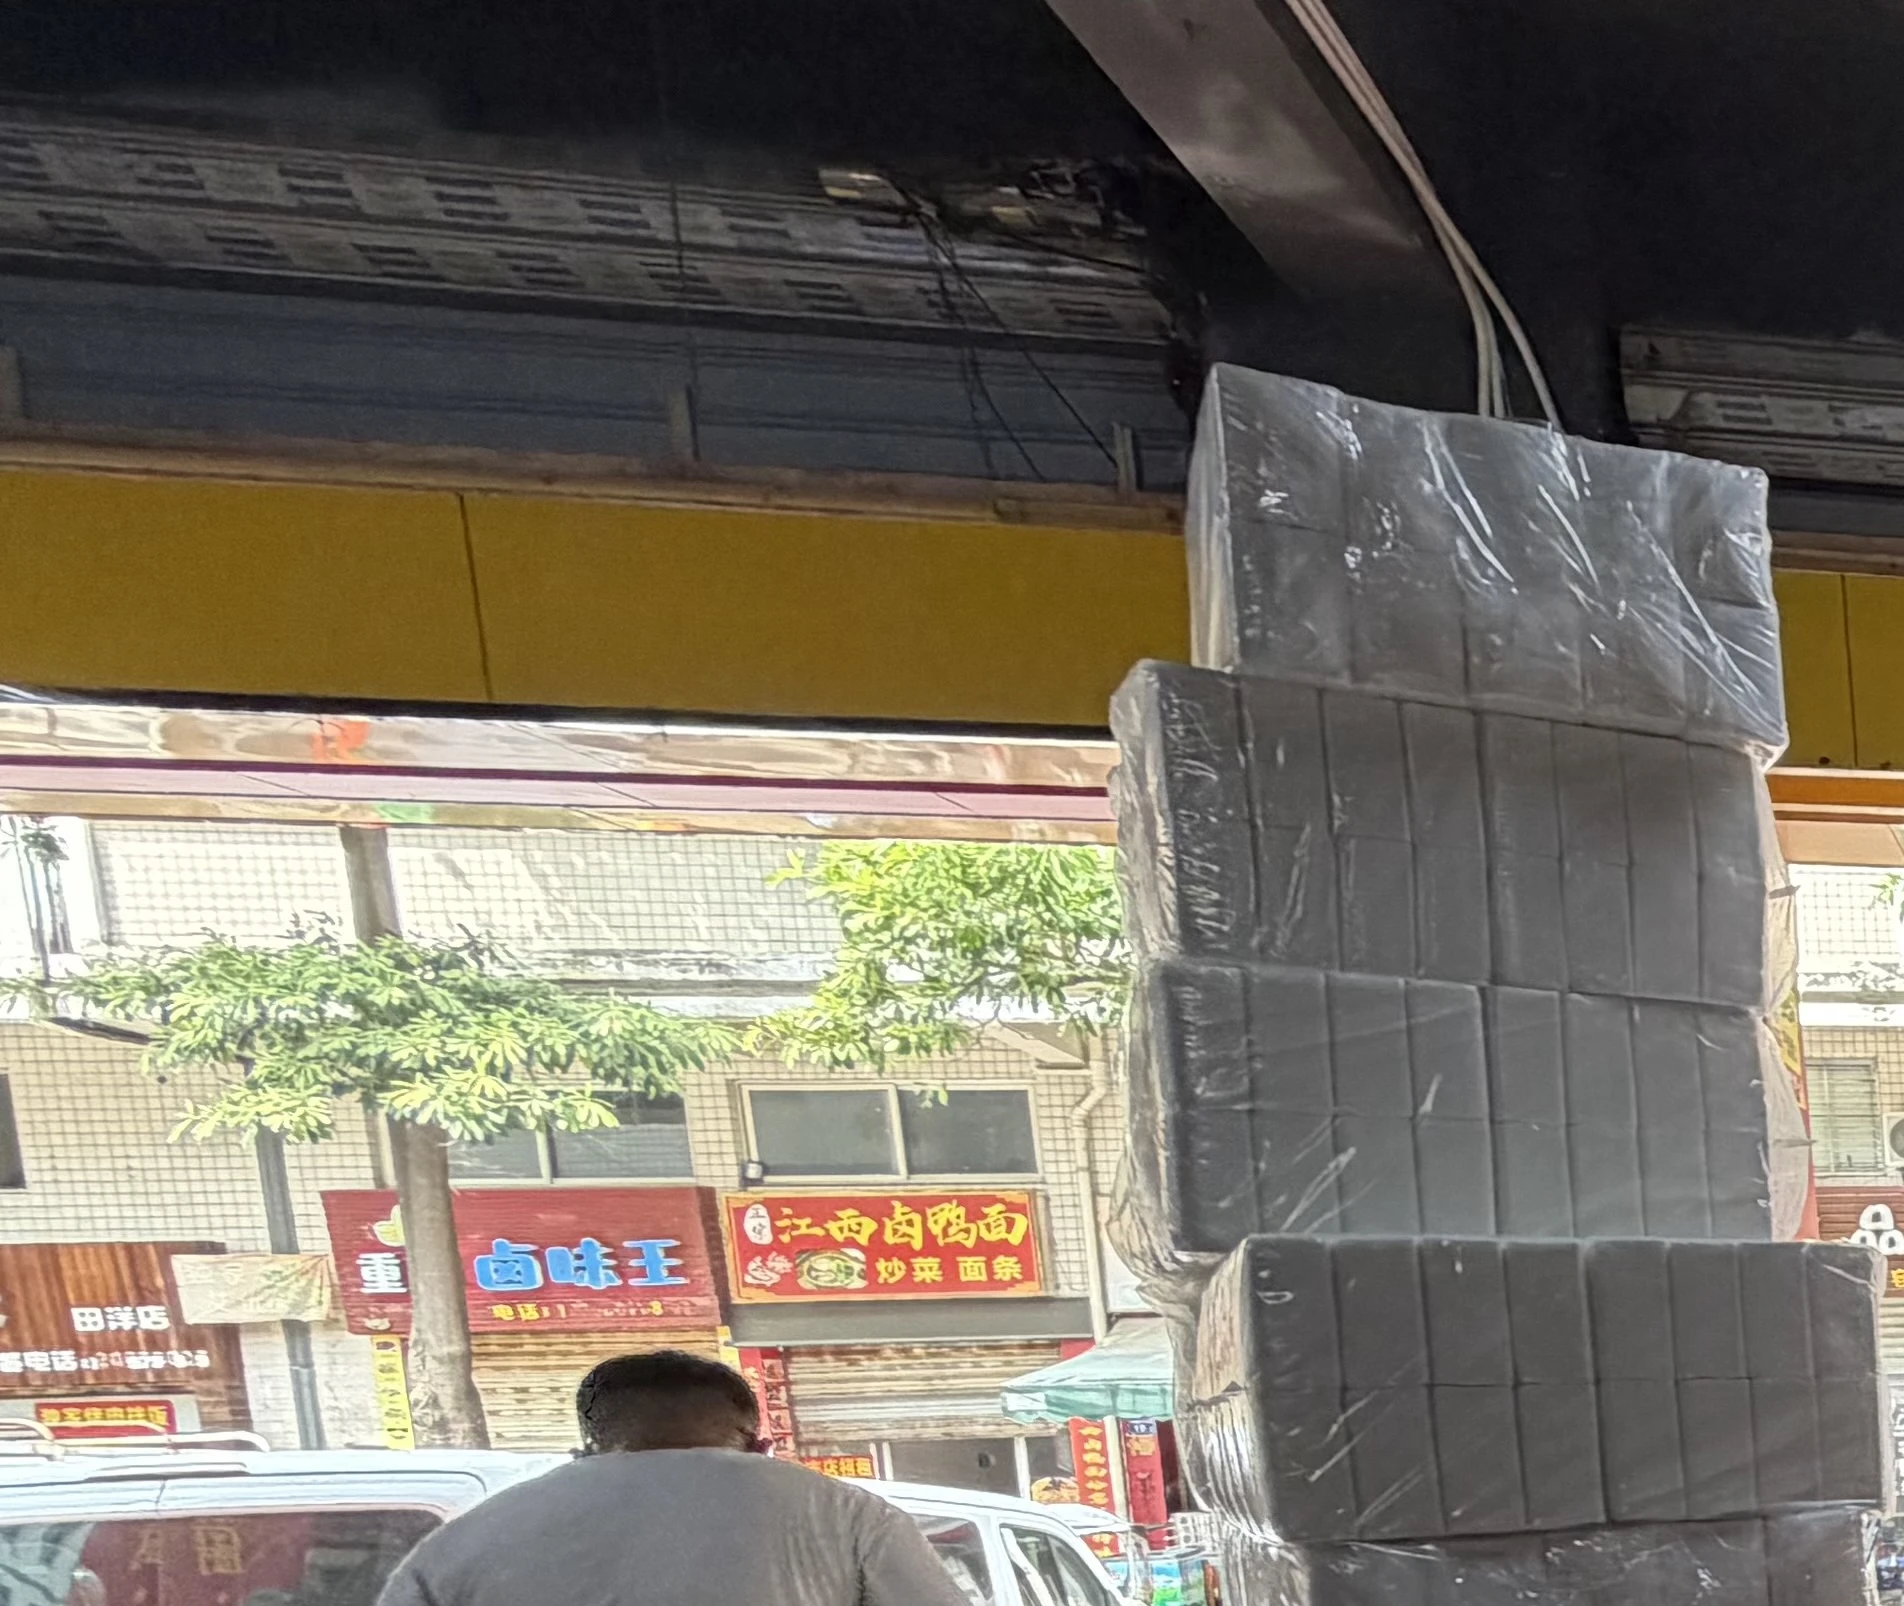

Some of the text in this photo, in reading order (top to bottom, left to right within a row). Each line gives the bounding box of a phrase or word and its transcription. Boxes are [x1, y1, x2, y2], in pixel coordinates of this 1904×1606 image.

[775, 1200, 1029, 1250] 江西卤鸭面
[474, 1237, 690, 1291] 卤味王
[875, 1255, 1024, 1284] 炒菜 面条
[70, 1305, 172, 1333] 田洋店
